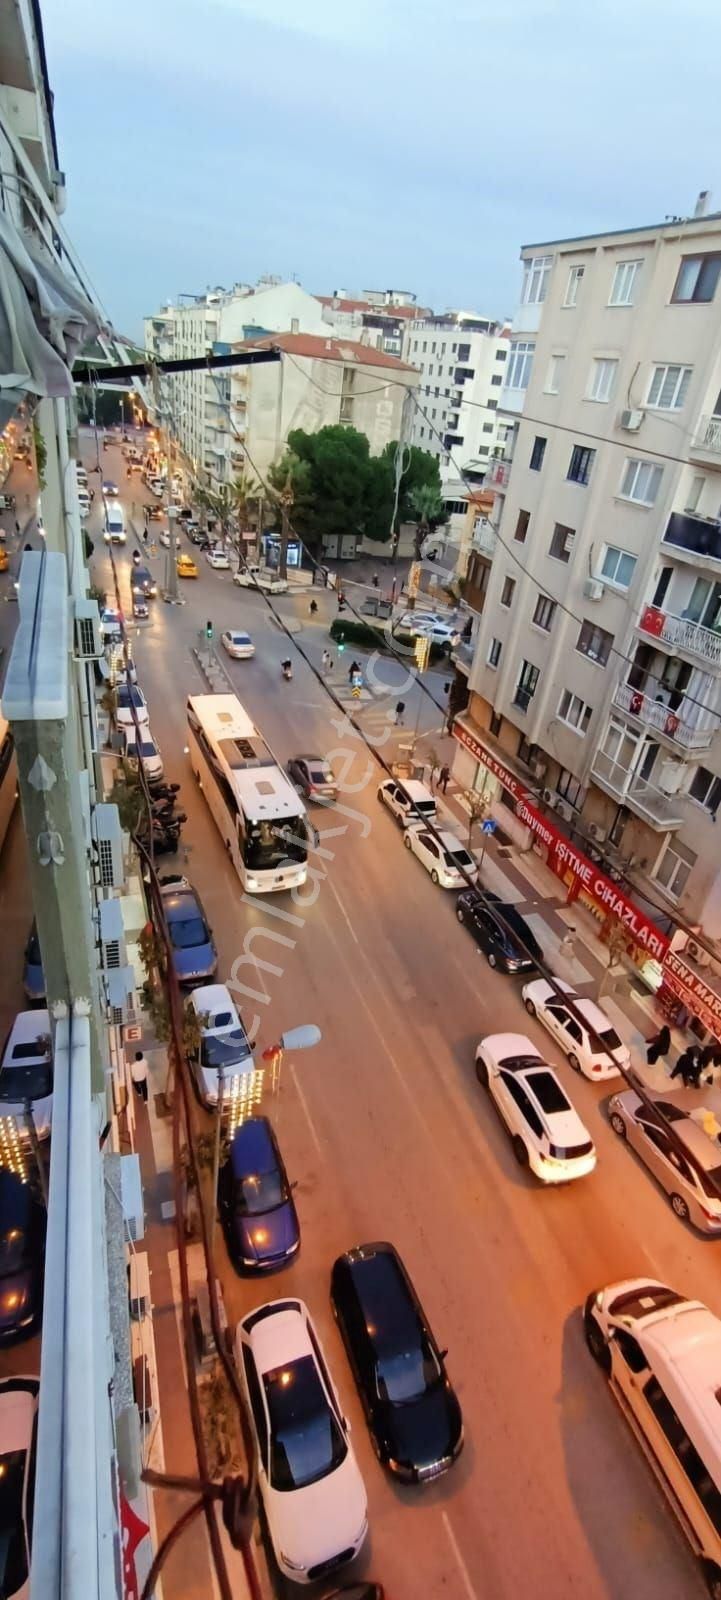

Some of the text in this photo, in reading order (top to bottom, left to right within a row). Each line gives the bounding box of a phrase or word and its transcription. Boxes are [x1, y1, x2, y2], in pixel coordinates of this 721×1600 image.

[461, 732, 517, 792] ECZANE TUNÇ
[665, 955, 694, 987] SENA
[127, 1027, 138, 1040] E
